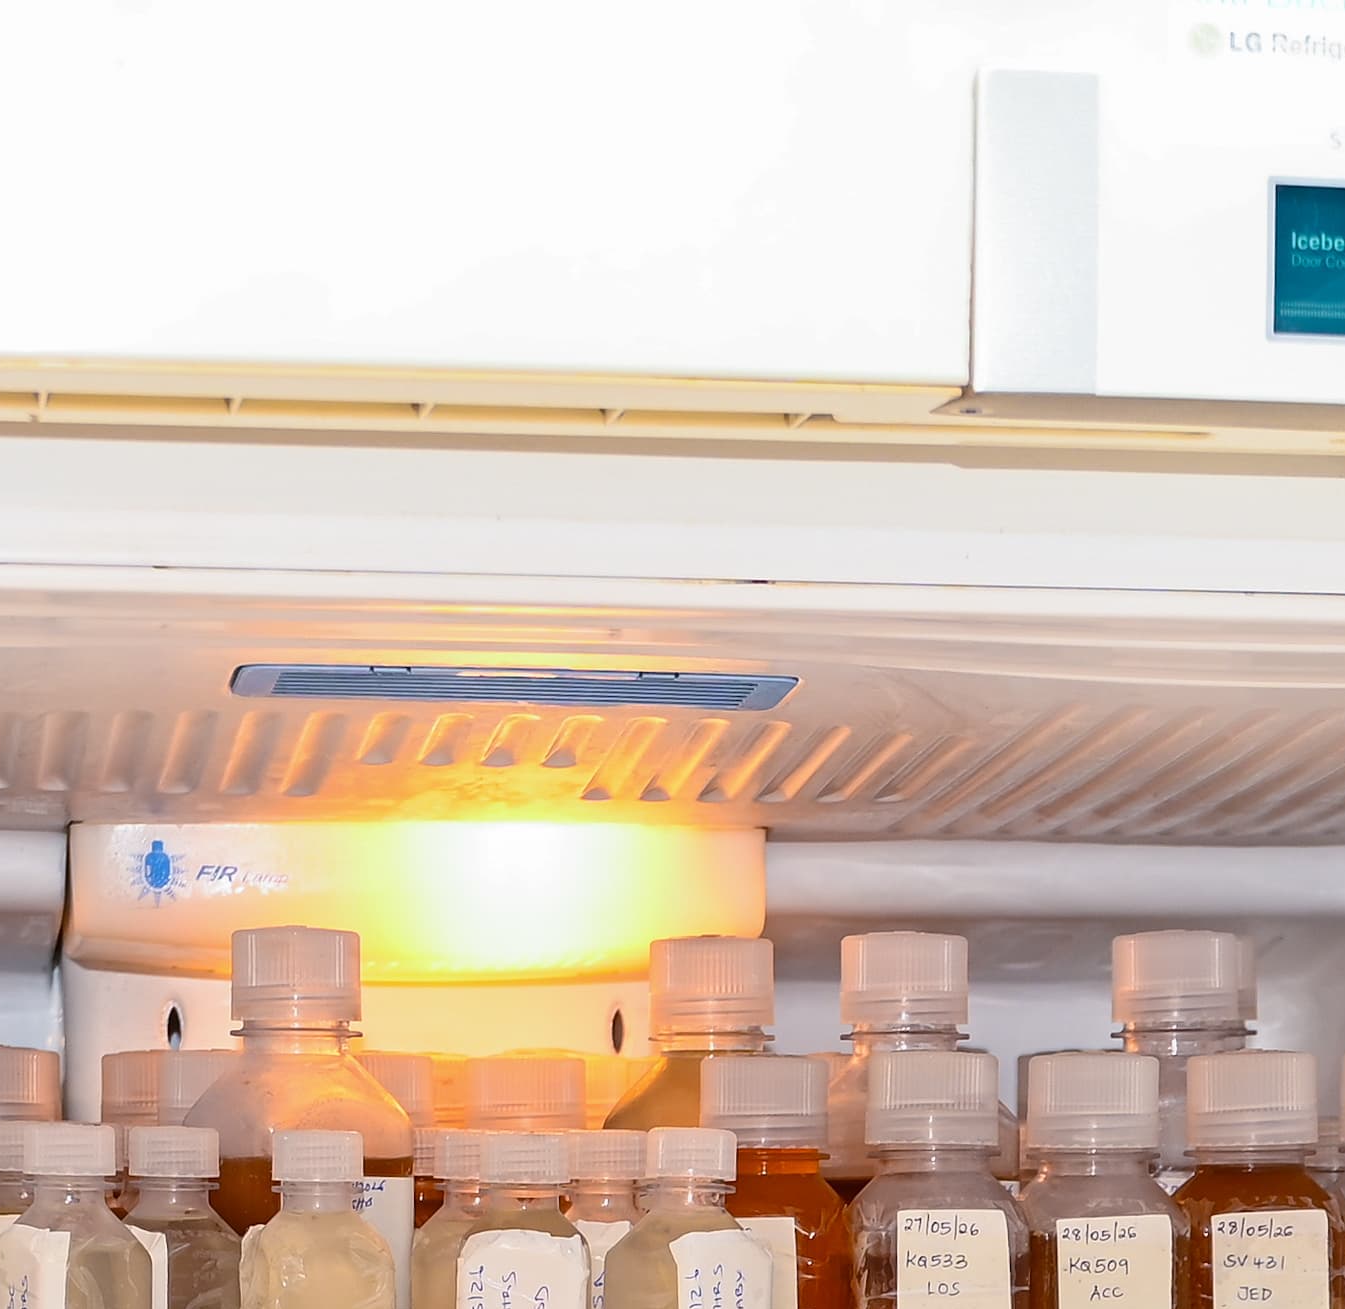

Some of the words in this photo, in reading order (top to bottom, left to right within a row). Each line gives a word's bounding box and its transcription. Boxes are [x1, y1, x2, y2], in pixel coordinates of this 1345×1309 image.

[1229, 31, 1263, 53] LG
[1291, 254, 1322, 268] Door
[903, 1217, 980, 1239] 27/05/26
[1062, 1223, 1137, 1244] 28/05/26
[1218, 1219, 1294, 1240] 28/05/26
[927, 1281, 961, 1296] LOS
[1091, 1286, 1124, 1300] ACC
[1237, 1286, 1273, 1302] JED
